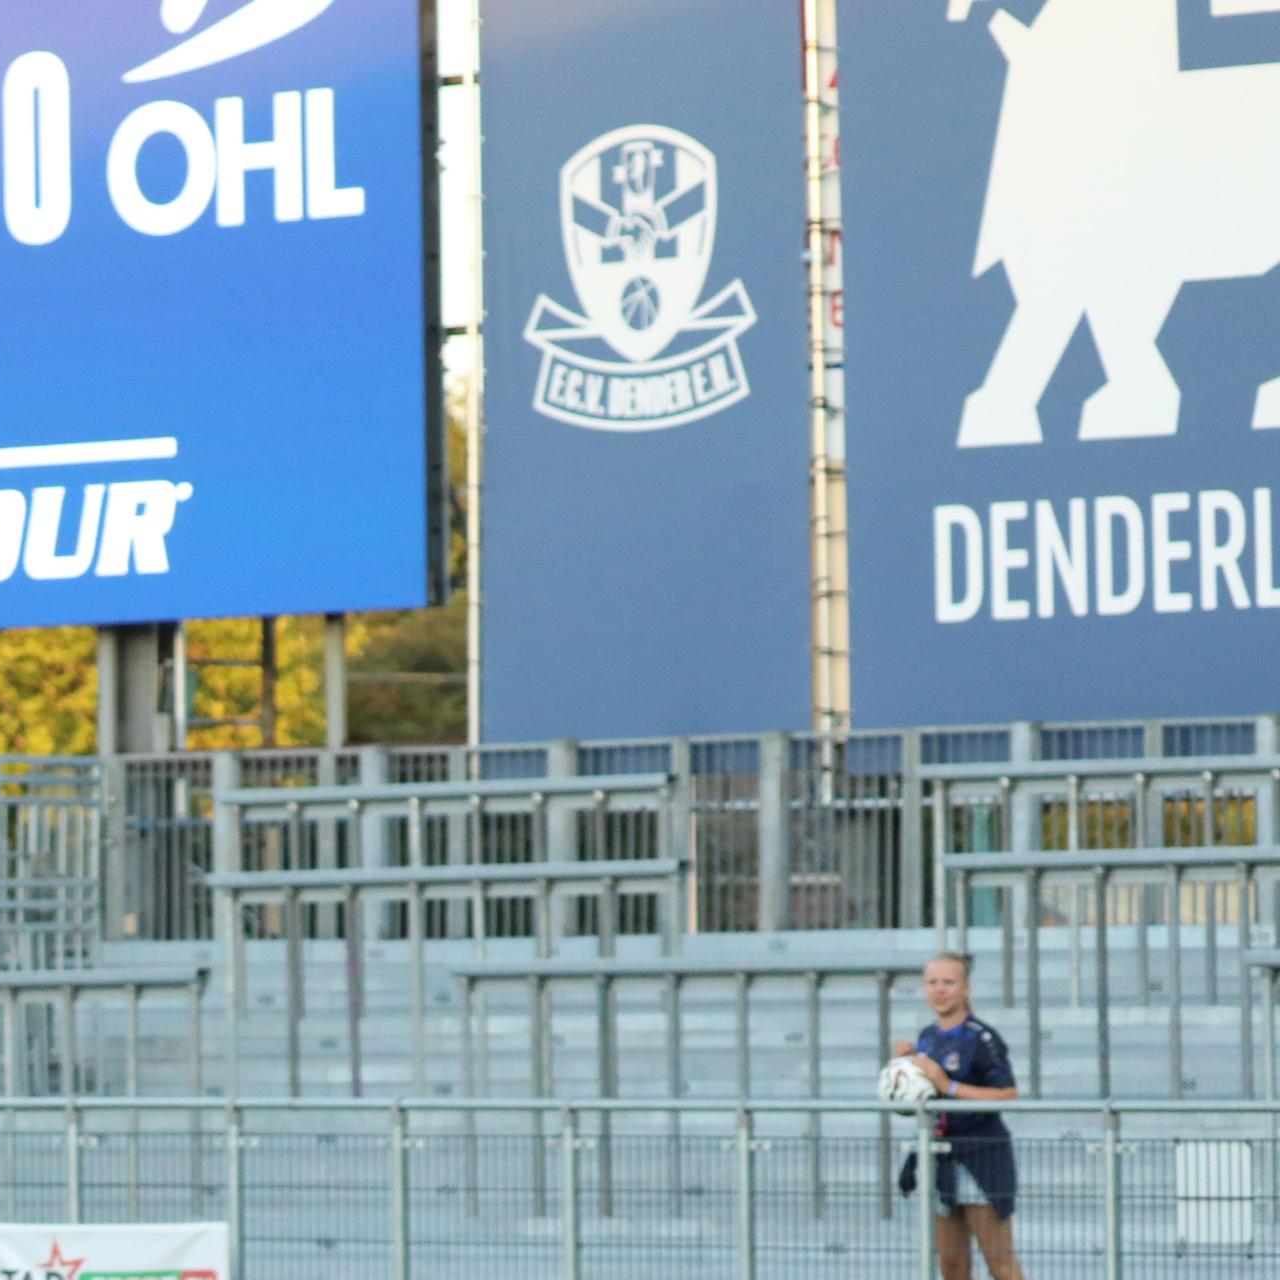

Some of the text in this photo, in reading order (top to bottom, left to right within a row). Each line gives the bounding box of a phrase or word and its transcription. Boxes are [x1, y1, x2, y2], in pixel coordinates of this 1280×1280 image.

[2, 50, 71, 246] 0
[106, 86, 366, 237] OHL
[933, 487, 1280, 624] DENDERL
